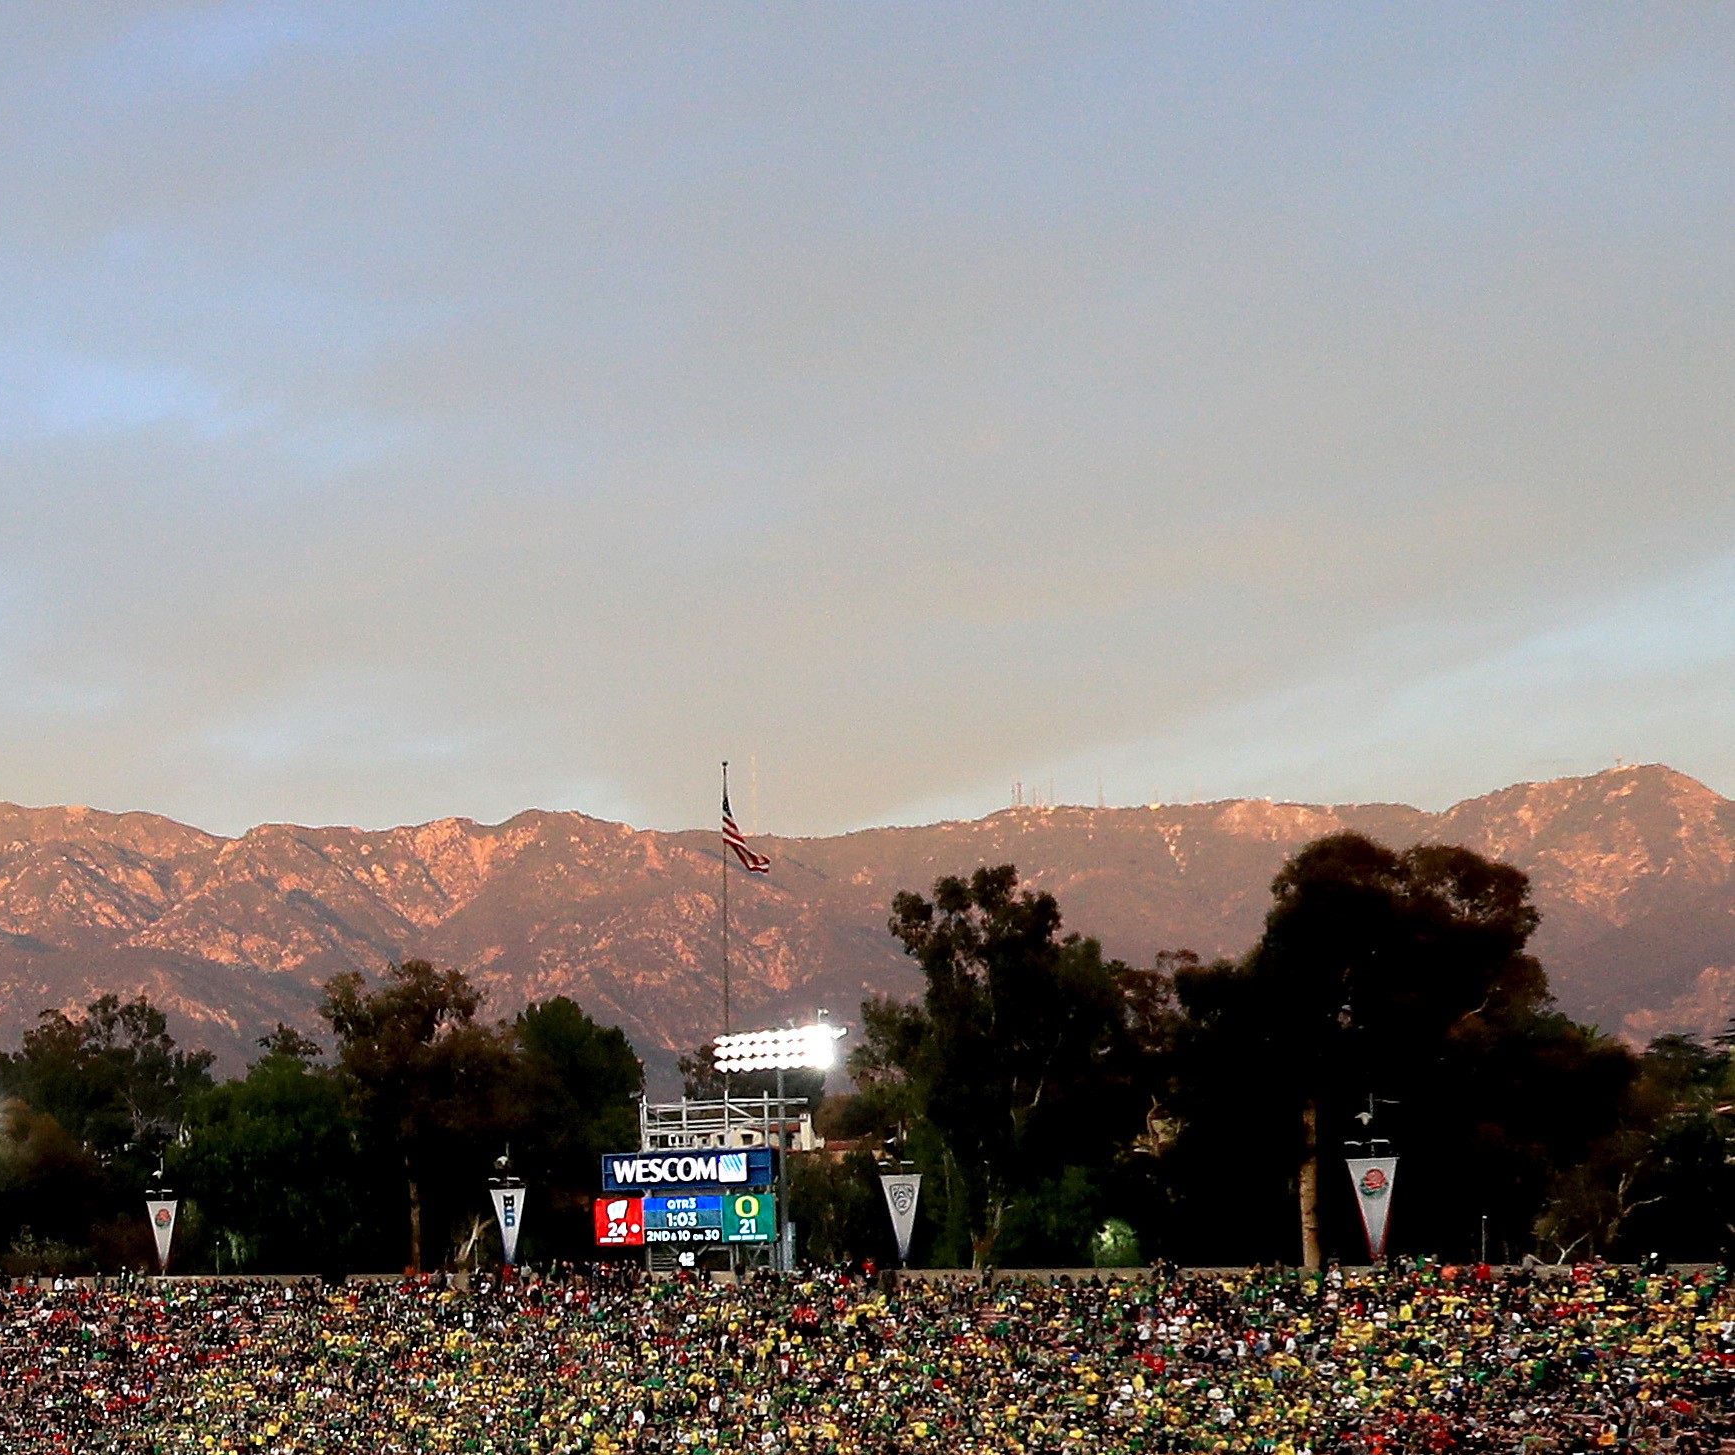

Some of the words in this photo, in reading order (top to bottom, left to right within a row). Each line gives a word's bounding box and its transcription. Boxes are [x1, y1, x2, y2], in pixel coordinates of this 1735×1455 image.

[613, 1156, 717, 1183] WESCOM
[667, 1200, 697, 1210] QTR3
[734, 1196, 760, 1218] O
[666, 1212, 697, 1226] 1:03
[740, 1219, 756, 1233] 21
[608, 1222, 628, 1237] 24
[646, 1231, 670, 1242] 2ND
[678, 1231, 691, 1241] 10
[705, 1230, 720, 1241] 30
